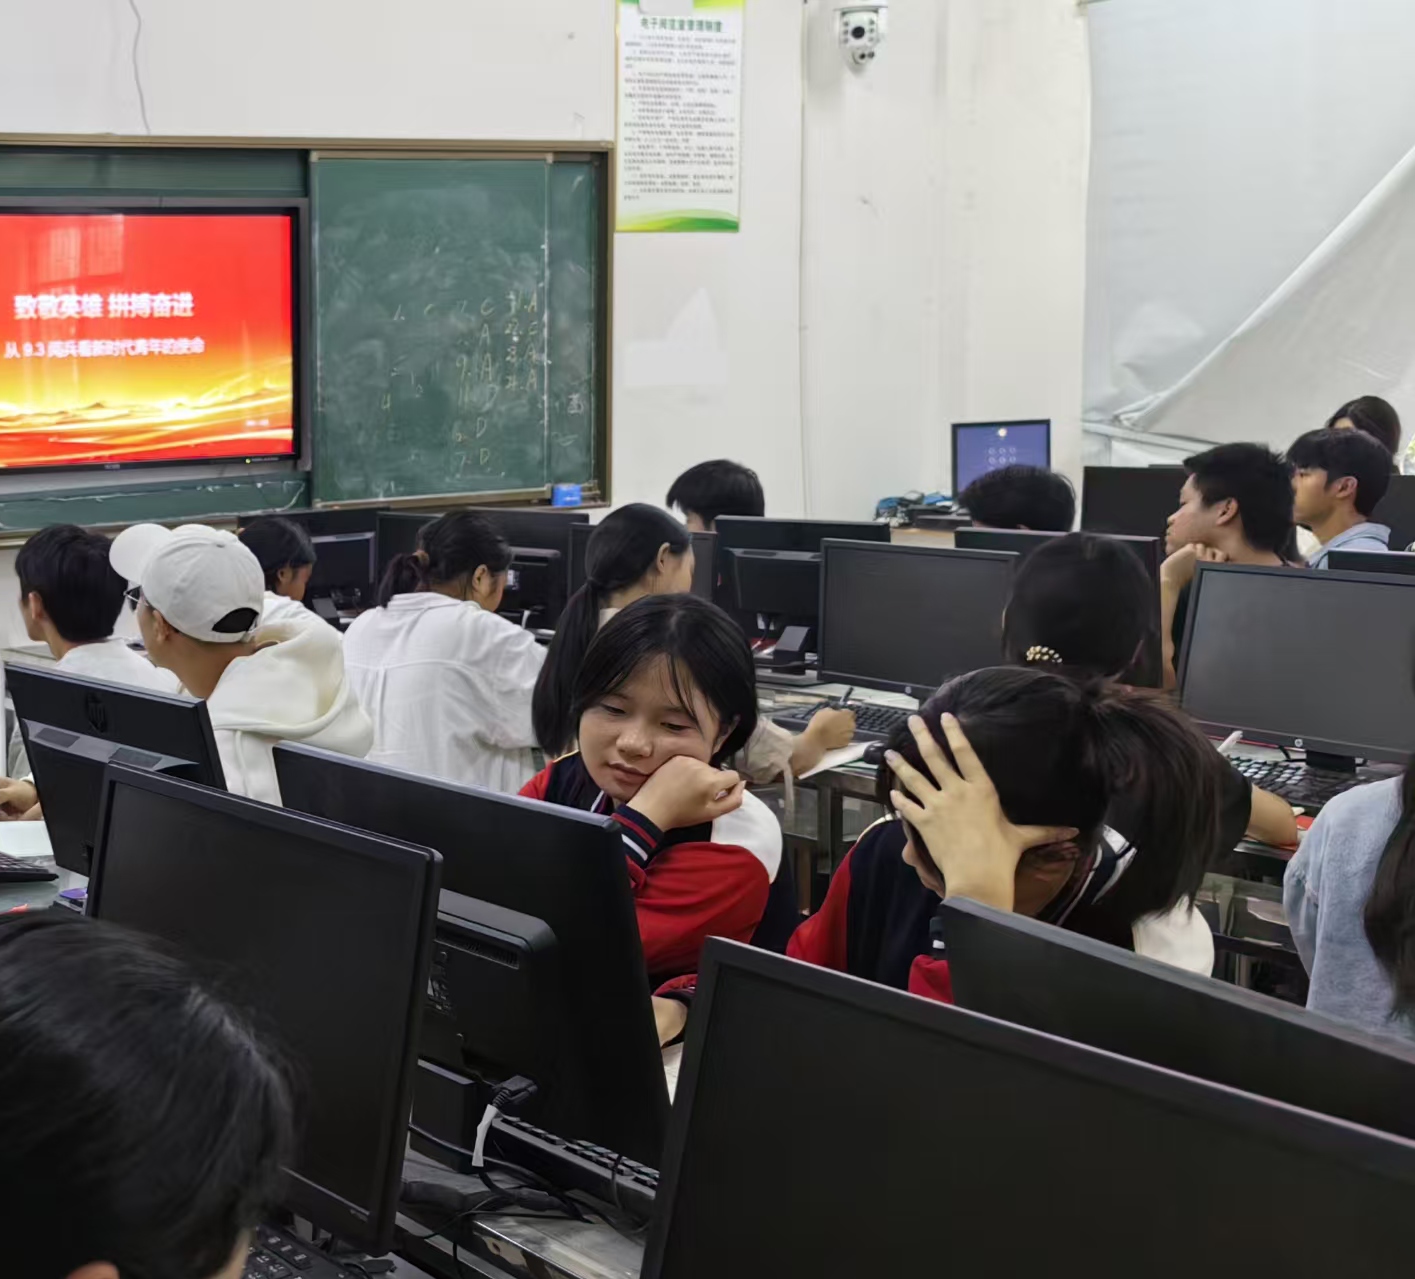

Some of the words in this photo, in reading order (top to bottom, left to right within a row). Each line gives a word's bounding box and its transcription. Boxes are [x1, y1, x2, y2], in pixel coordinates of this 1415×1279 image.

[14, 293, 103, 319] 致敬英雄
[108, 292, 194, 318] 拼搏奋进
[4, 341, 21, 359] 从
[22, 341, 46, 358] 9.3
[47, 336, 205, 358] 阅兵看新时代青年的使命
